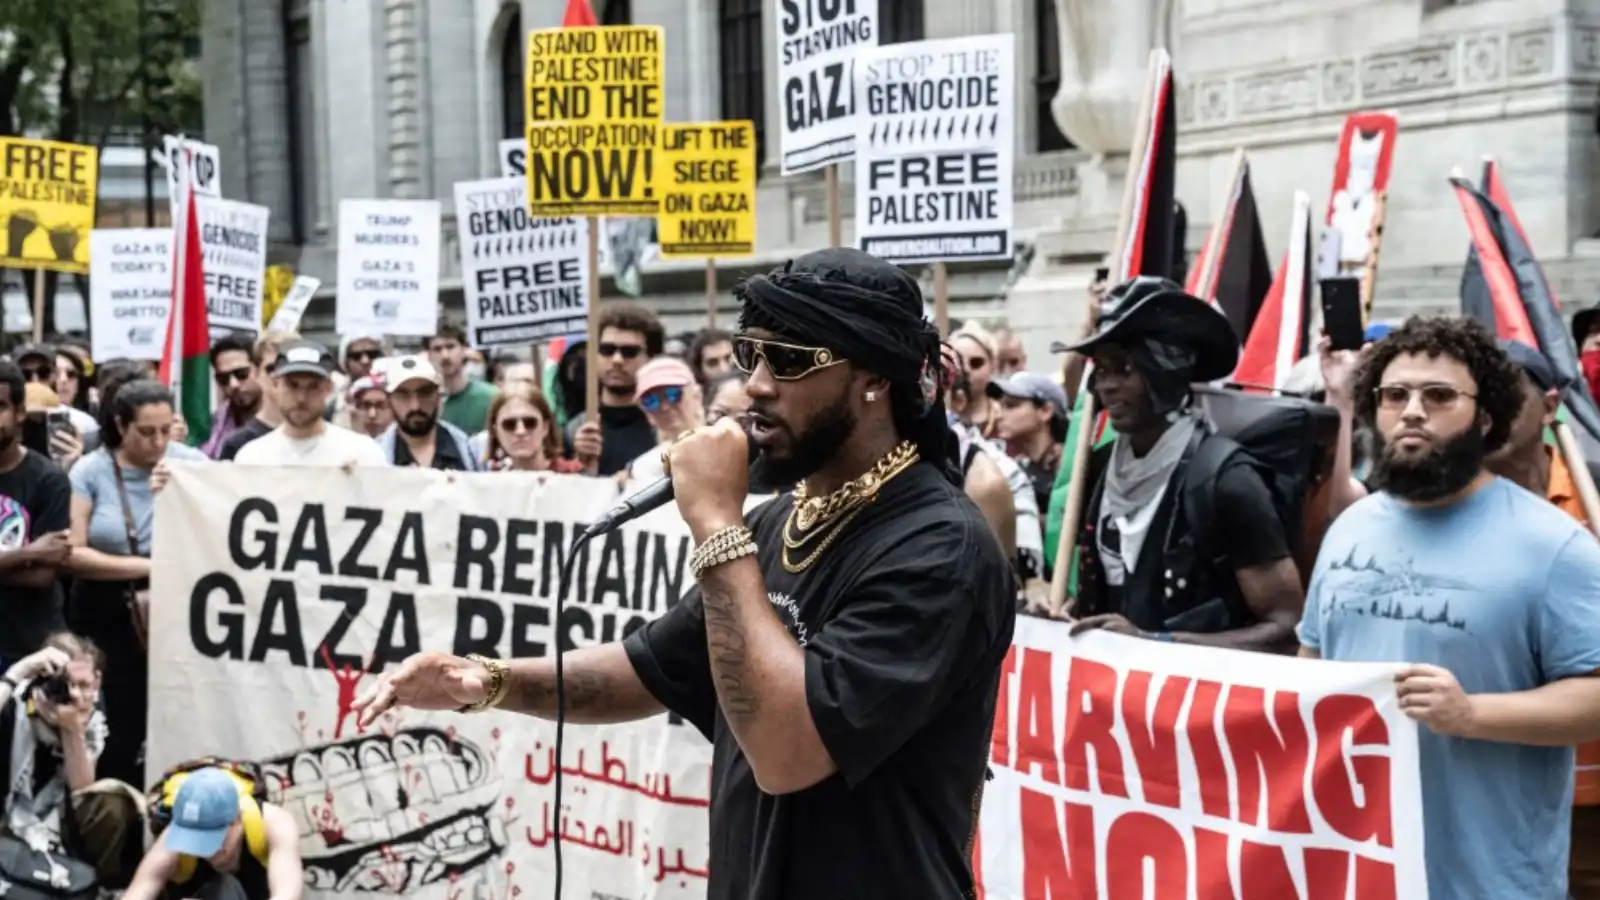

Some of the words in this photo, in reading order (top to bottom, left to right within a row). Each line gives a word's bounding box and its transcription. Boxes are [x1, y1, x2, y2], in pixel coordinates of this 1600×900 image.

[532, 31, 597, 56] STAND
[604, 30, 658, 53] WITH
[783, 16, 870, 66] STARVING
[532, 57, 658, 83] PALESTINE!
[866, 54, 933, 83] STOP
[942, 49, 999, 75] THE
[531, 85, 590, 120] END
[601, 84, 659, 119] THE
[868, 75, 999, 116] GENOCIDE
[530, 124, 656, 150] OCCUPATION
[663, 129, 700, 150] LIFT
[709, 127, 748, 148] THE
[5, 143, 87, 185] FREE
[532, 149, 653, 200] NOW!
[674, 160, 739, 183] SIEGE
[869, 152, 998, 190] FREE
[0, 180, 91, 207] PALESTINE
[465, 188, 523, 212] STOP
[665, 193, 692, 213] ON
[700, 192, 748, 212] GAZA
[868, 190, 998, 225] PALESTINE
[680, 219, 737, 240] NOW!
[476, 258, 581, 292] FREE
[206, 297, 255, 322] ALESTINE
[479, 285, 583, 319] PALESTINE
[228, 496, 431, 585] GAZA
[189, 572, 421, 673] GAZA
